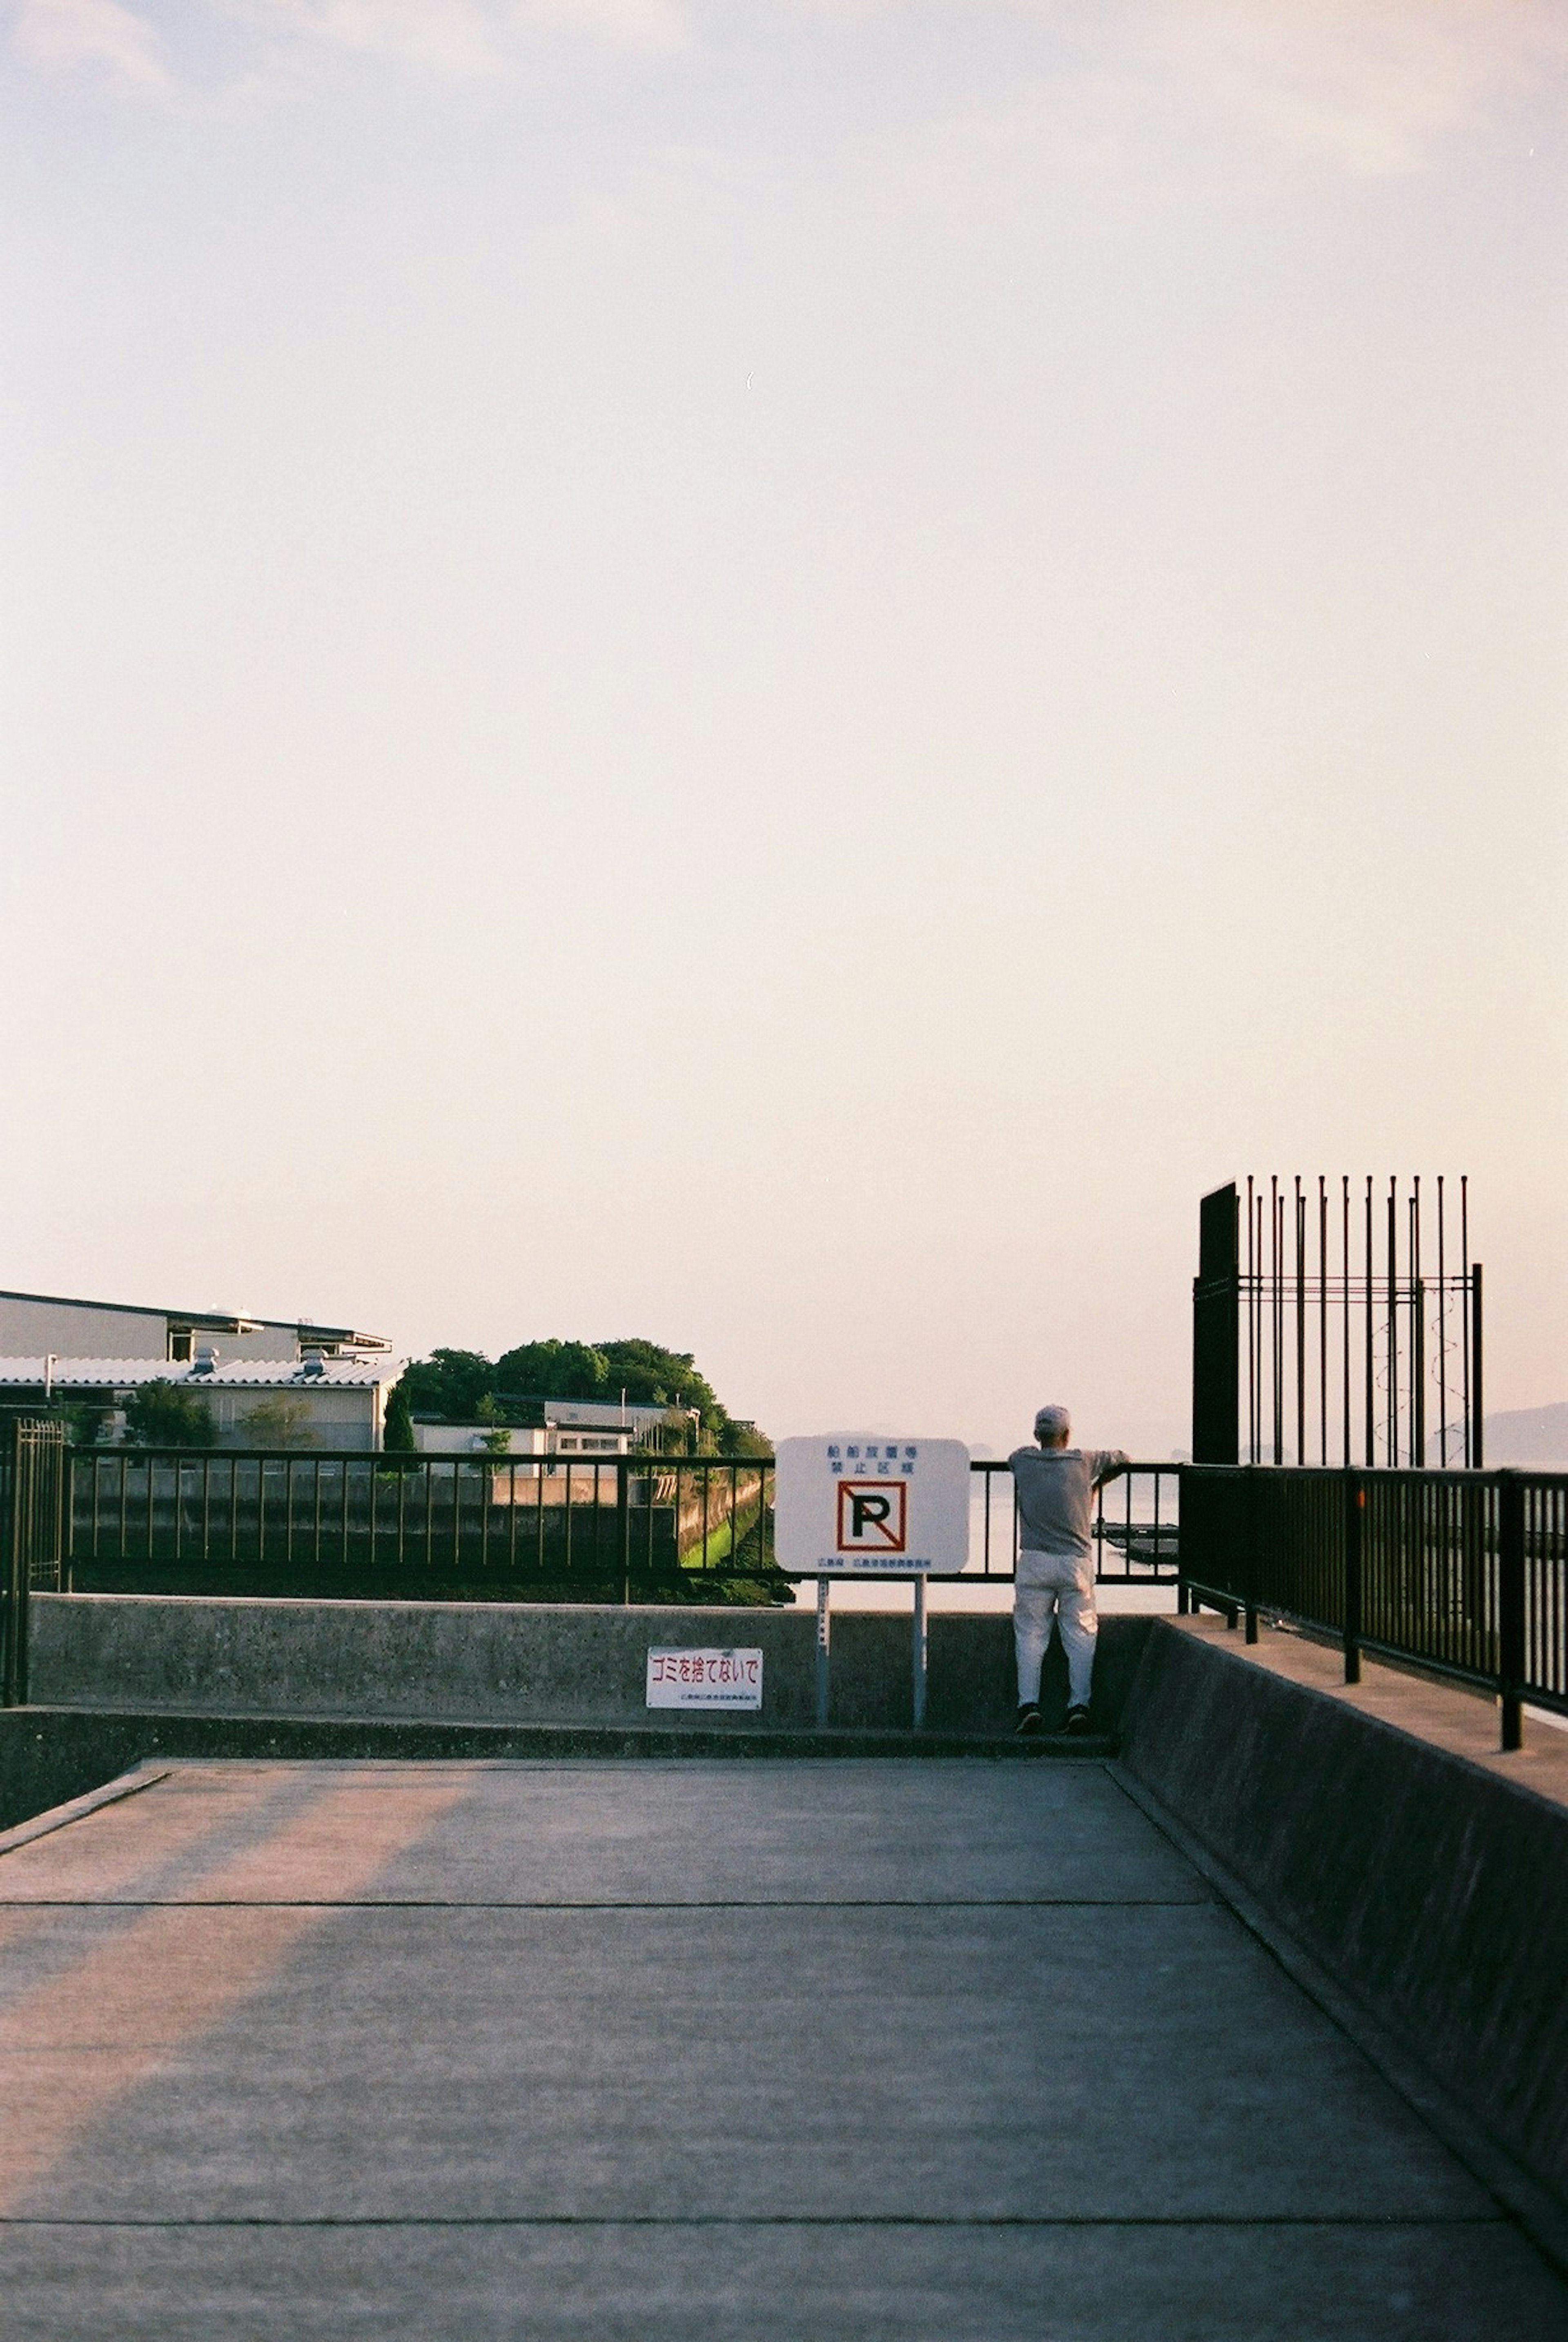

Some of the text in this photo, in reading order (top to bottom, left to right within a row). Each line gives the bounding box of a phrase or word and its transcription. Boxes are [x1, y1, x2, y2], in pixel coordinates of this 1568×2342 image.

[653, 1656, 758, 1683] ゴミを捨てないで
